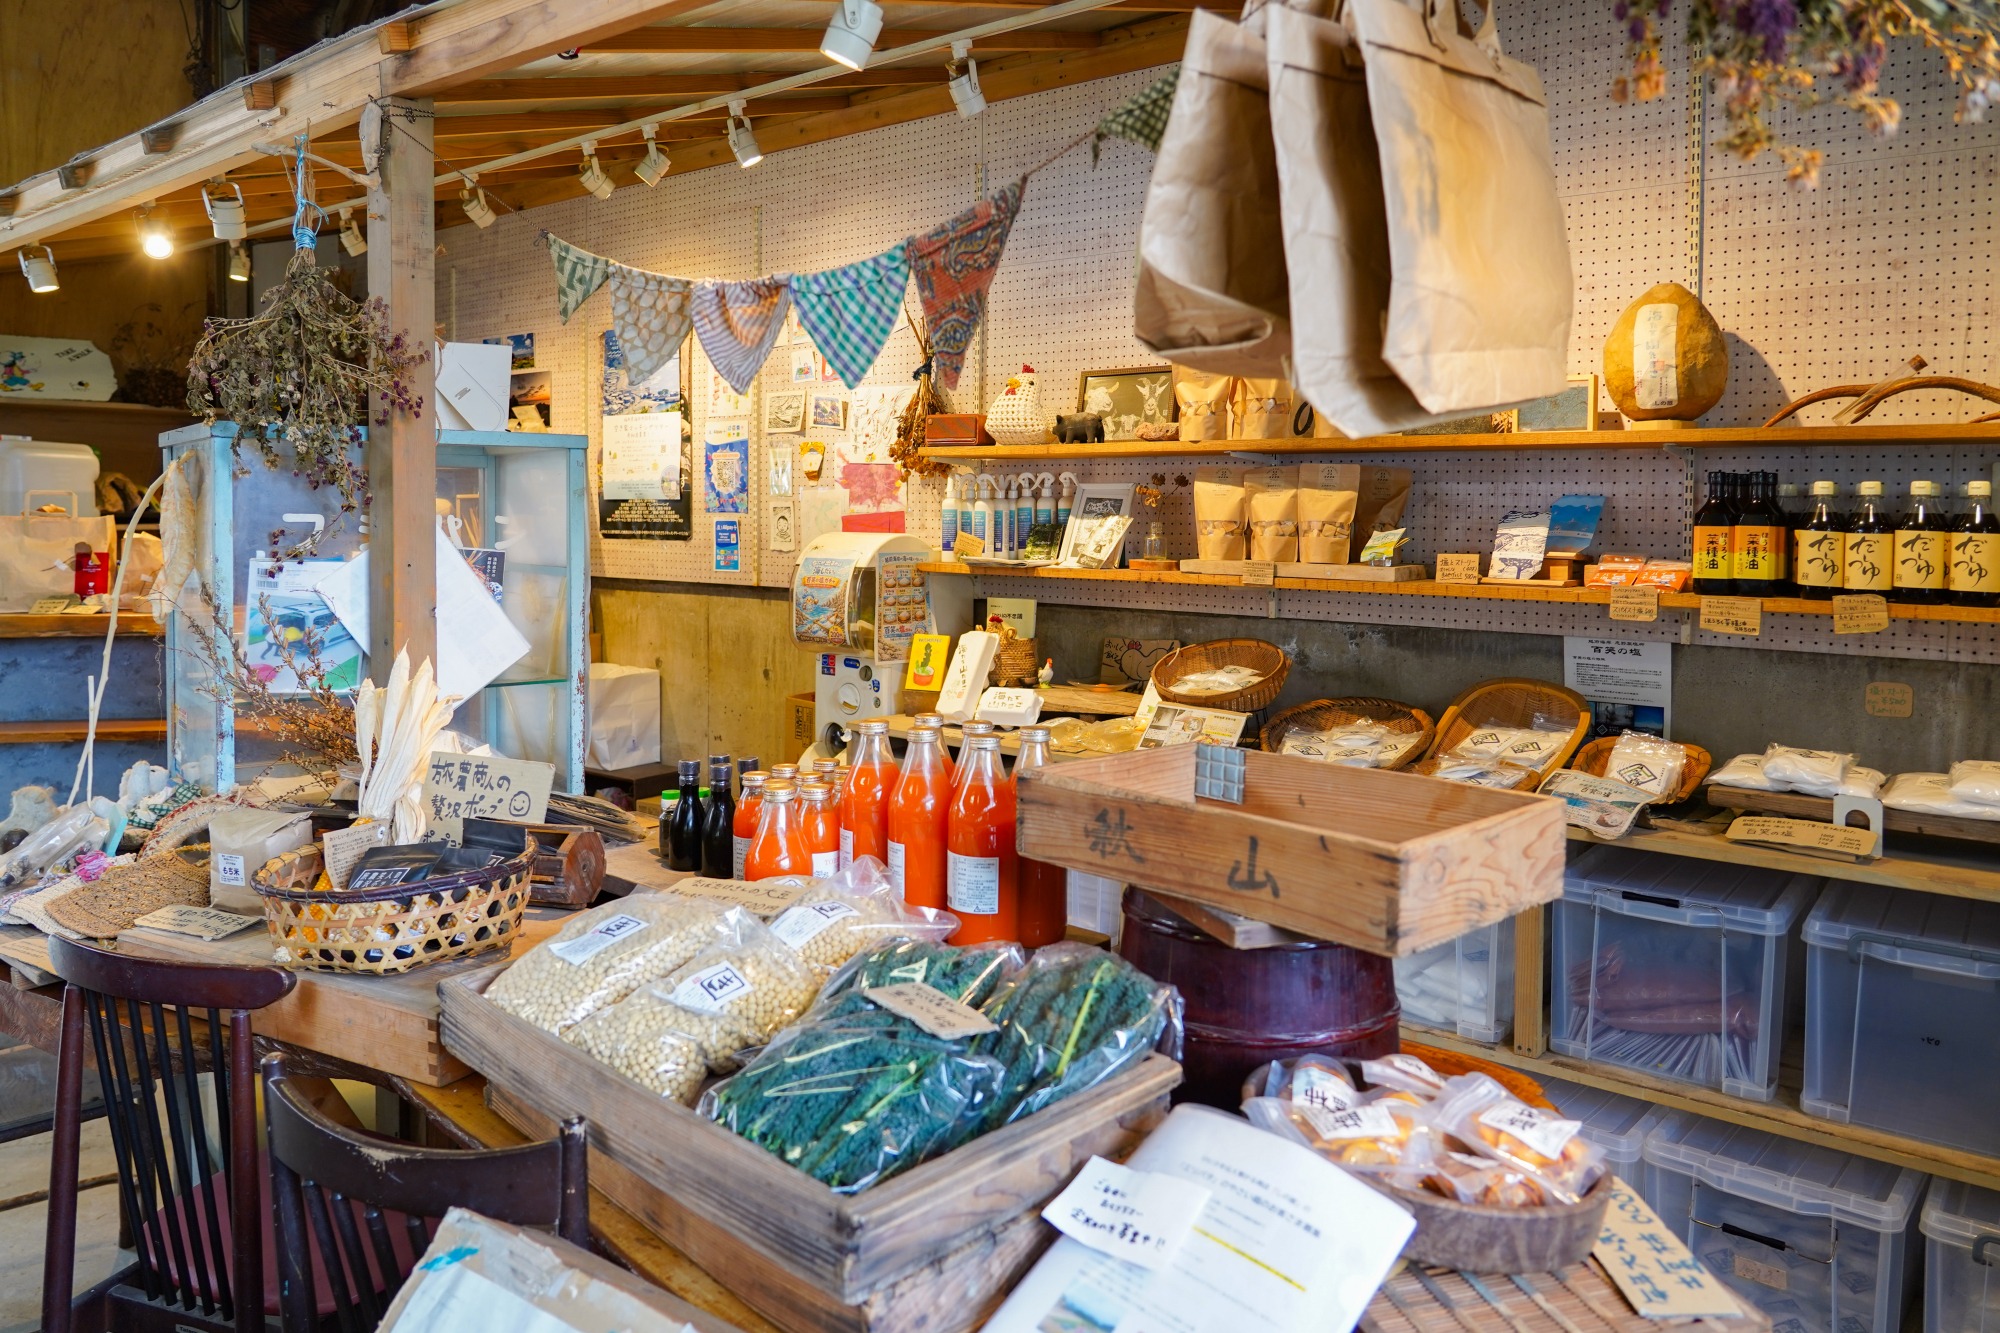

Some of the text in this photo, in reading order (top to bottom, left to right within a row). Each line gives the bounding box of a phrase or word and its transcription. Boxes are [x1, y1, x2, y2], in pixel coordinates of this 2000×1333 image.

[55, 347, 76, 358] TAKE
[1705, 533, 1719, 570] 菜種油
[1721, 532, 1729, 561] ほうろく
[1745, 533, 1759, 570] 菜種油
[1761, 532, 1769, 561] ほうろく
[1591, 645, 1642, 657] 百笑の塩
[431, 757, 511, 792] 旅農商人の
[431, 793, 504, 821] 贅沢ポップ
[1747, 828, 1796, 838] 百笑の塩
[223, 866, 240, 876] もち米
